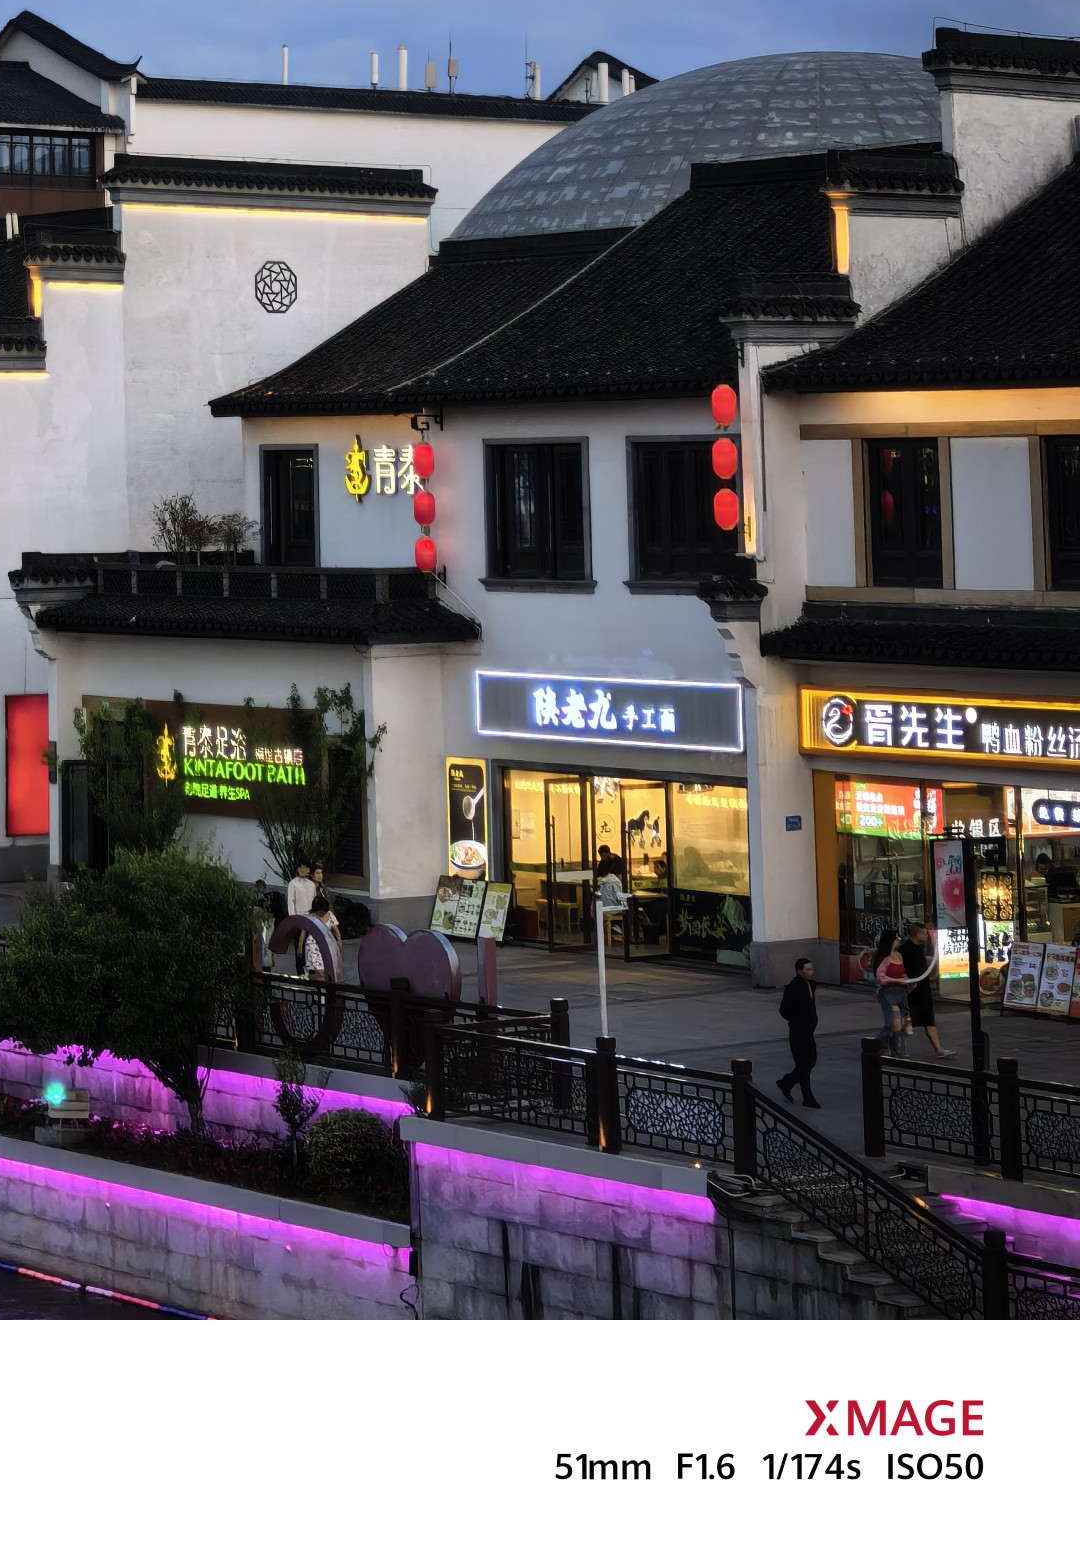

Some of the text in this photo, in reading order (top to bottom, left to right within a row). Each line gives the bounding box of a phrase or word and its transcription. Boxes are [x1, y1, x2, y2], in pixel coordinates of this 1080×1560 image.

[373, 444, 424, 495] 青泰
[532, 686, 617, 730] 陕老九
[622, 704, 676, 733] 手工面
[864, 703, 965, 749] 胥先生
[182, 726, 247, 761] 青泰足浴
